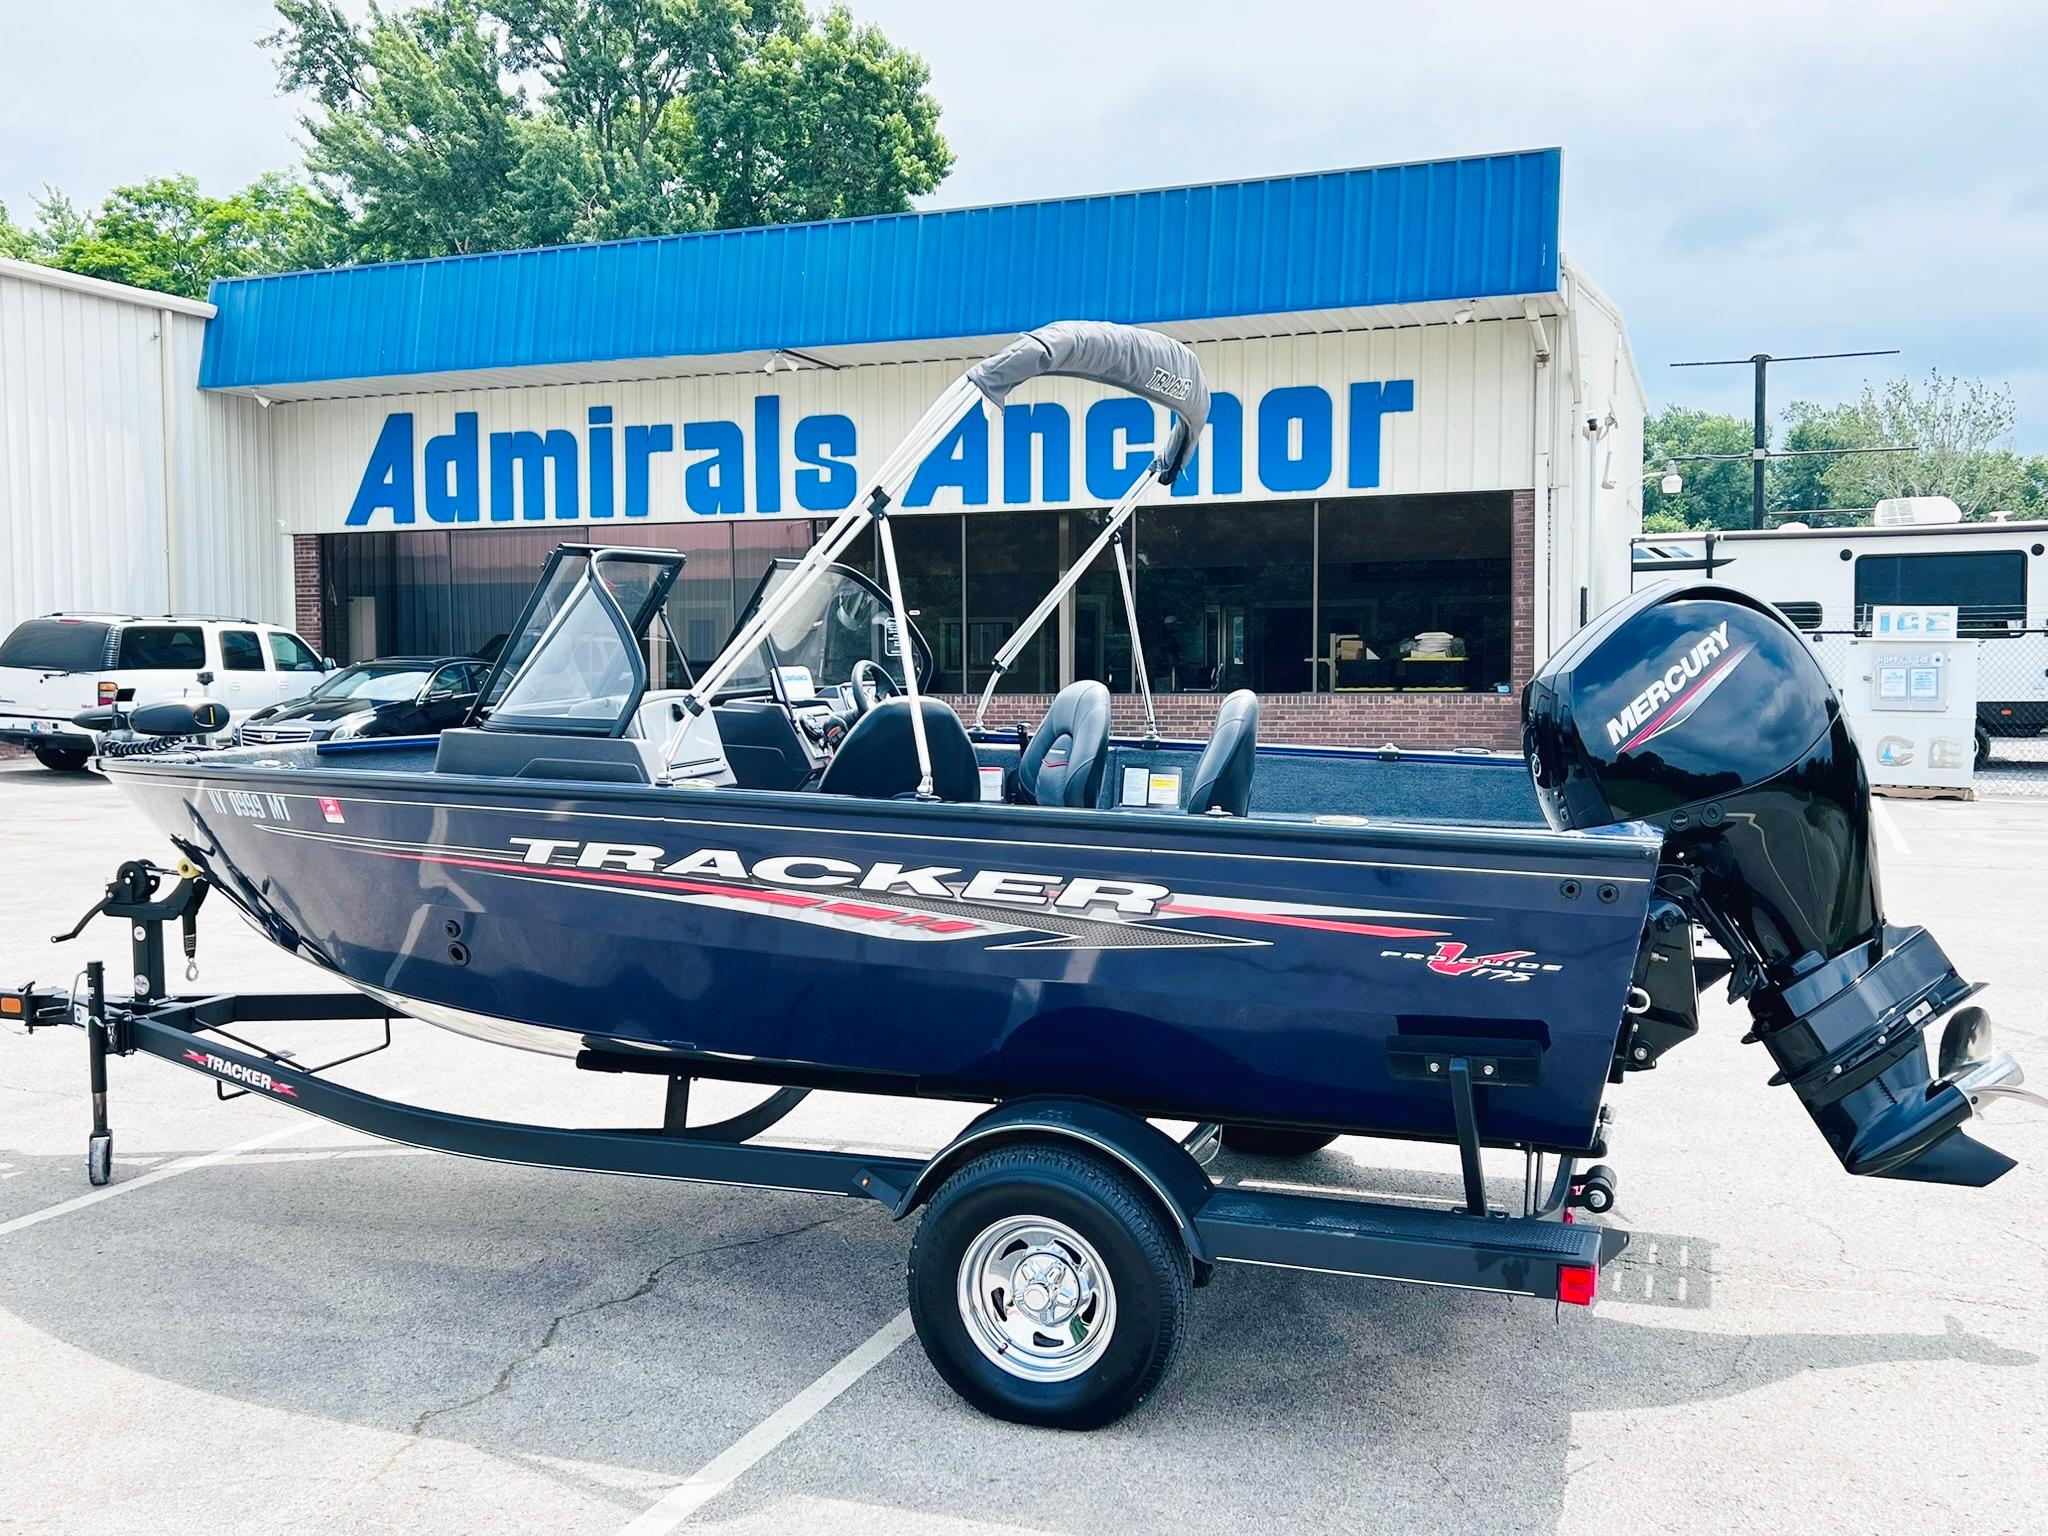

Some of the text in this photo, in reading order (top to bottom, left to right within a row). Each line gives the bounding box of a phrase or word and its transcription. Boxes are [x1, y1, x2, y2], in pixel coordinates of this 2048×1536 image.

[345, 380, 1414, 525] Admirals Anchor
[1880, 612, 1951, 634] ICE
[1606, 621, 1730, 746] MERCURY
[1857, 734, 1964, 769] CE
[228, 792, 266, 819] 0999
[266, 795, 291, 822] MT
[508, 836, 1171, 914] TRACKER
[1380, 950, 1449, 962] PRO
[1471, 968, 1536, 982] 175
[205, 1053, 272, 1090] TRACKER
